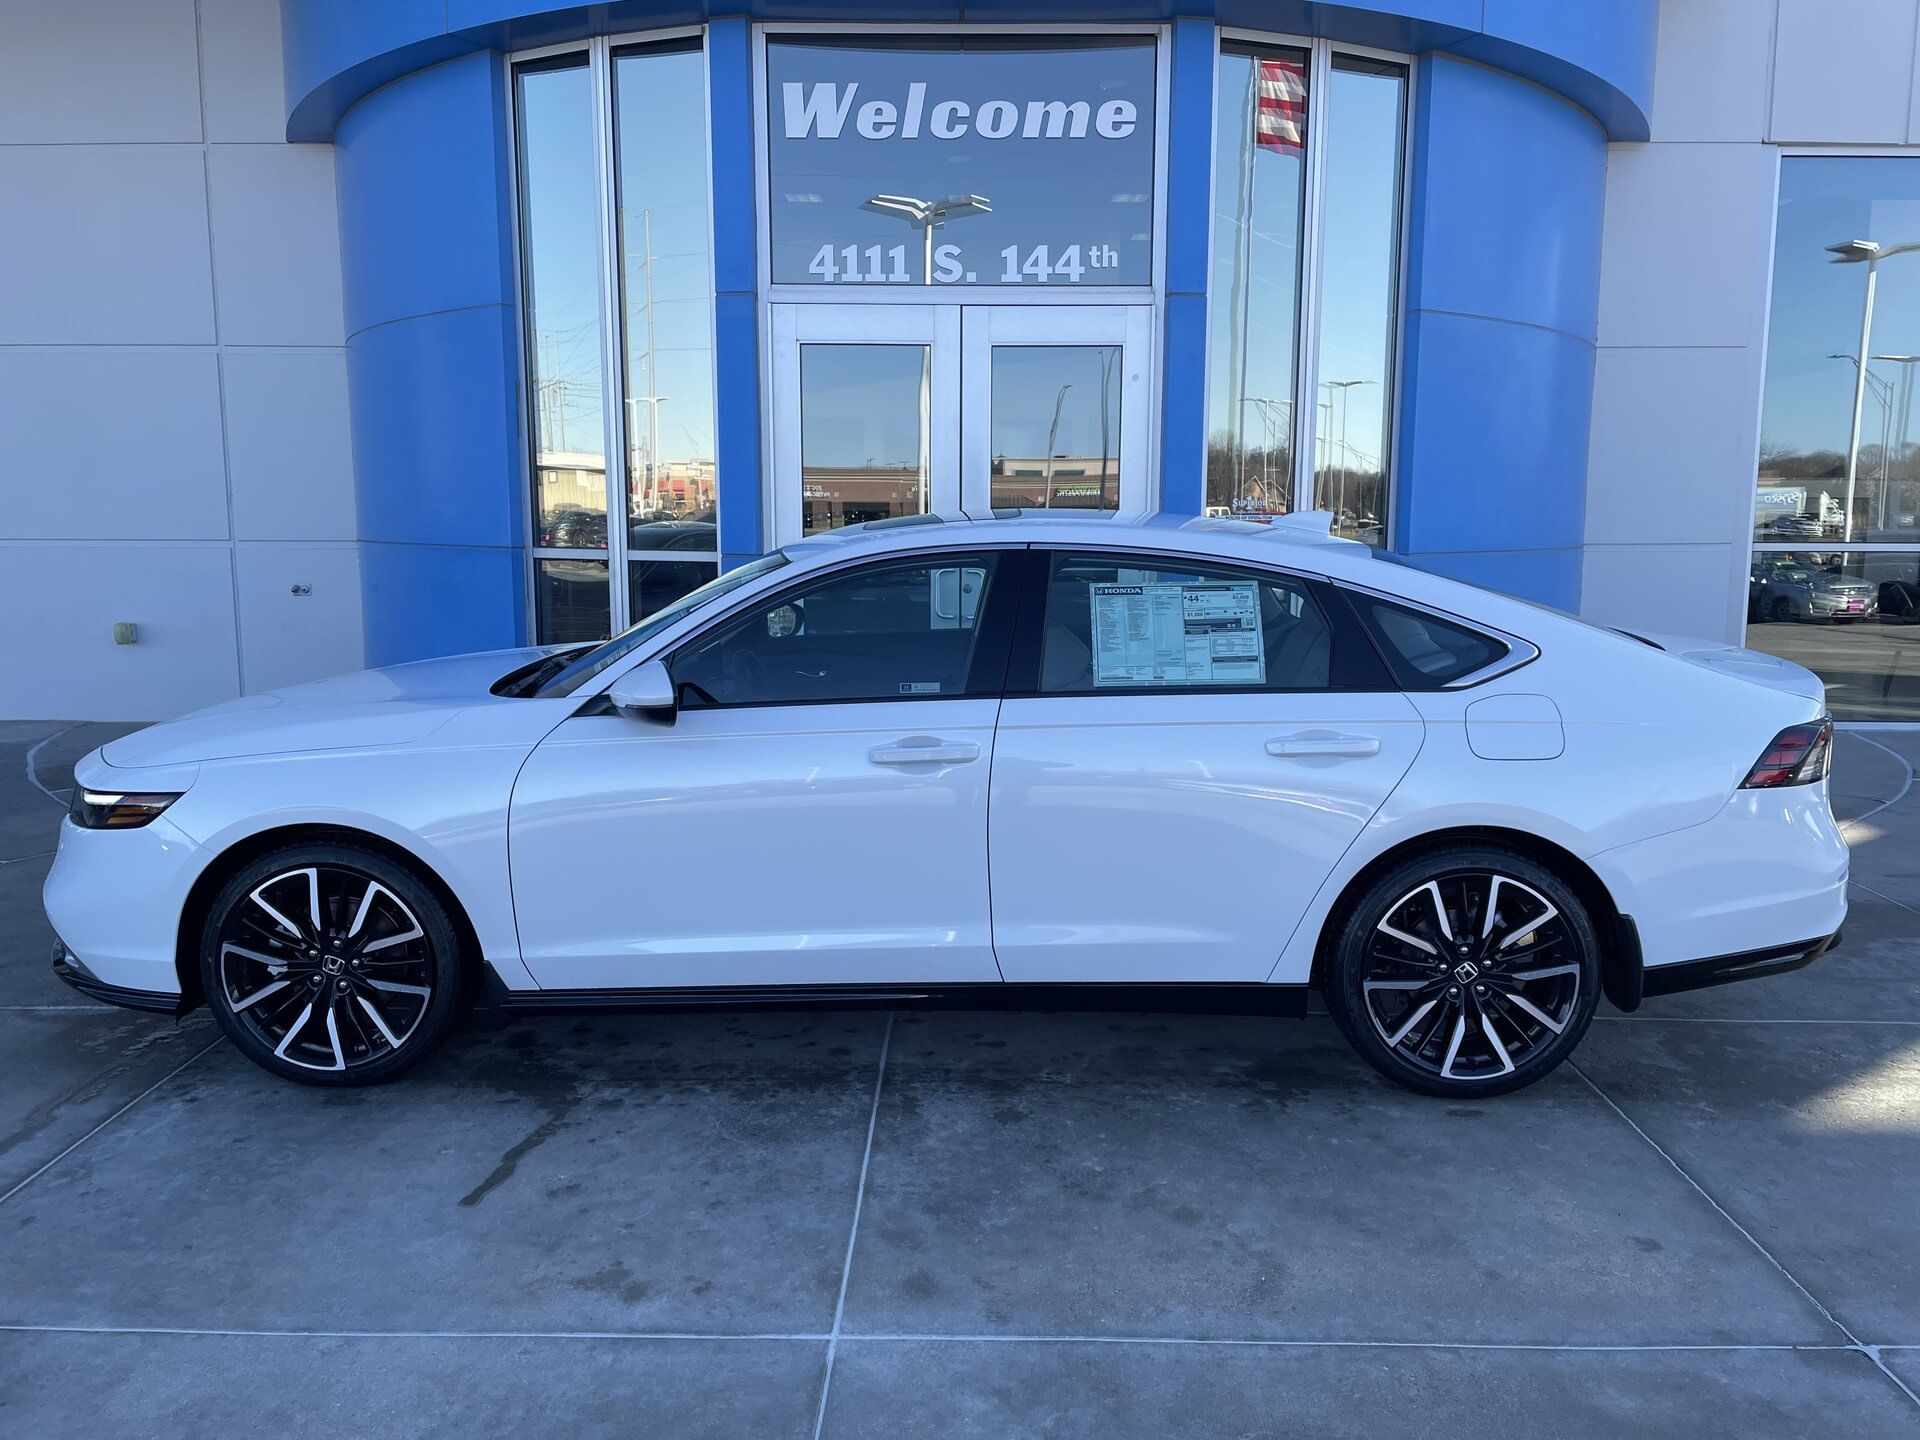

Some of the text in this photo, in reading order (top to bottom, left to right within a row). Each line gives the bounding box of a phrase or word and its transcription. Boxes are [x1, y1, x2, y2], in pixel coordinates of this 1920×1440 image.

[783, 82, 1138, 139] Welcome
[808, 244, 1118, 283] 4111 S. 144th
[1187, 594, 1200, 603] 44
